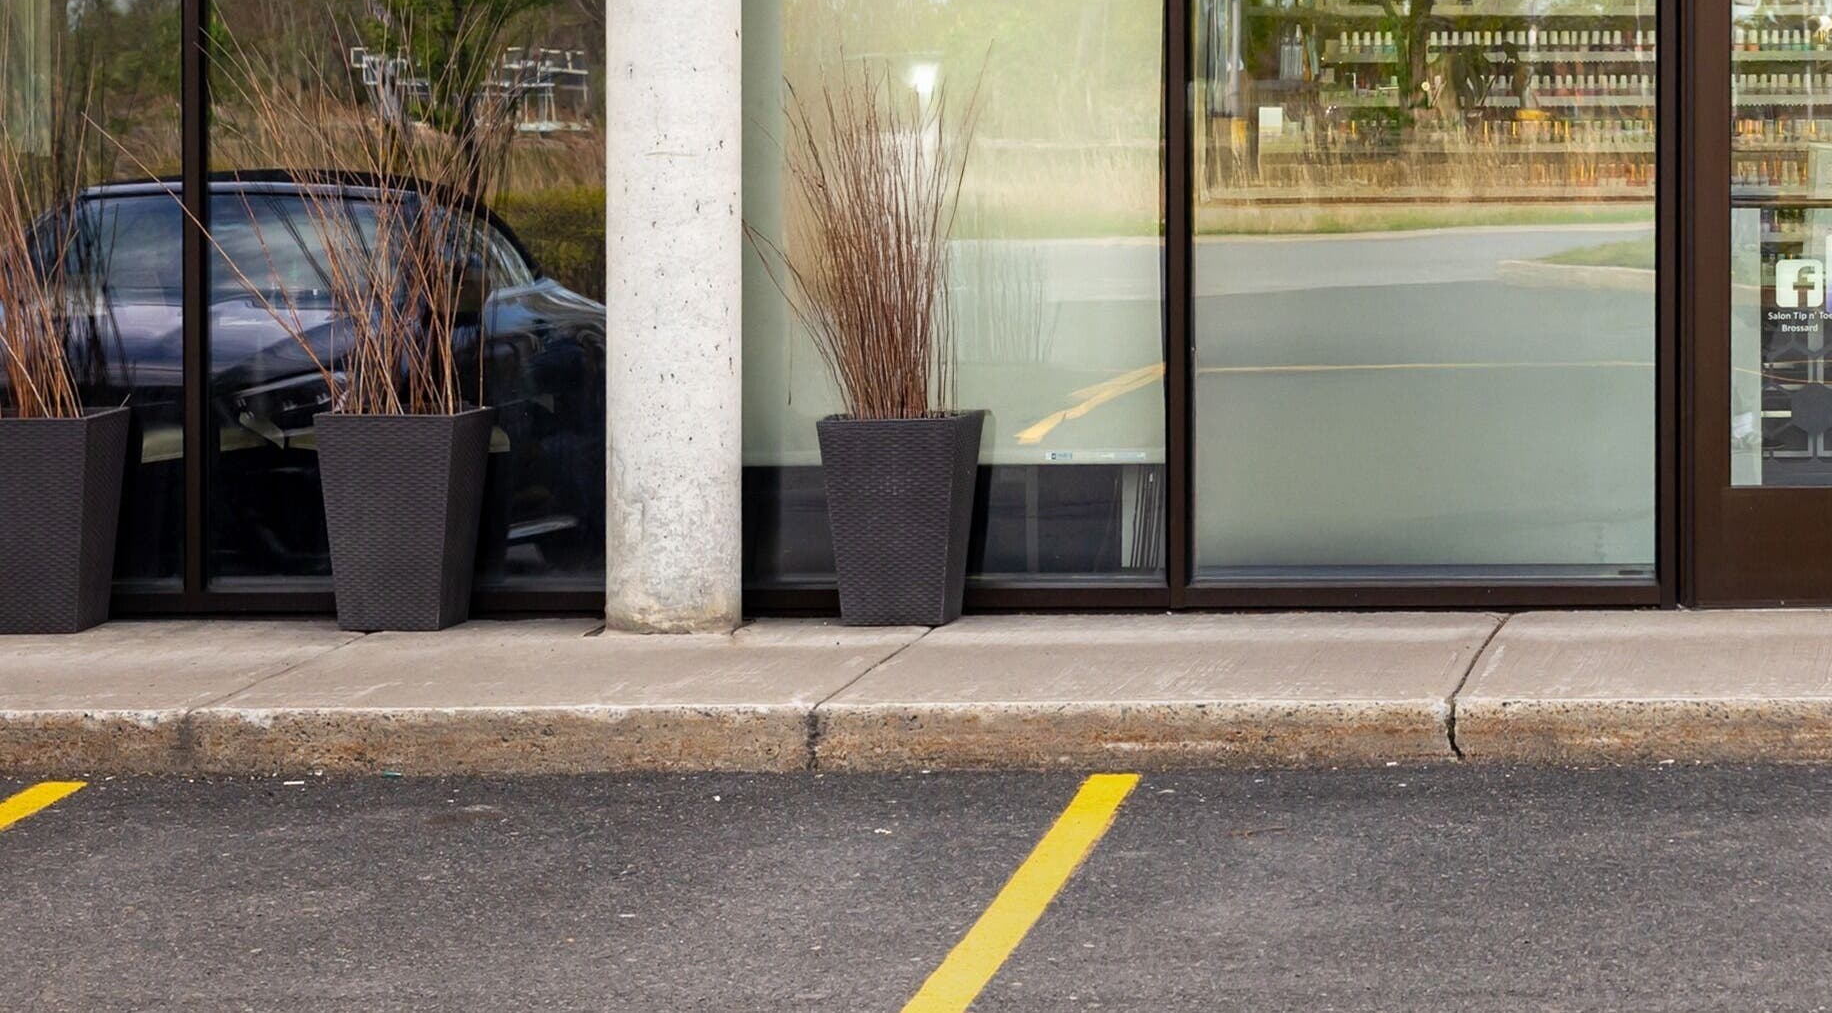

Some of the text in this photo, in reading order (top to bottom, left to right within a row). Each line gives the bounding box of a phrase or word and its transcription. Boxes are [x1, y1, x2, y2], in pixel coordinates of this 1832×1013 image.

[1767, 311, 1791, 320] Salon
[1793, 311, 1807, 321] Tip
[1781, 324, 1818, 332] Brossard
